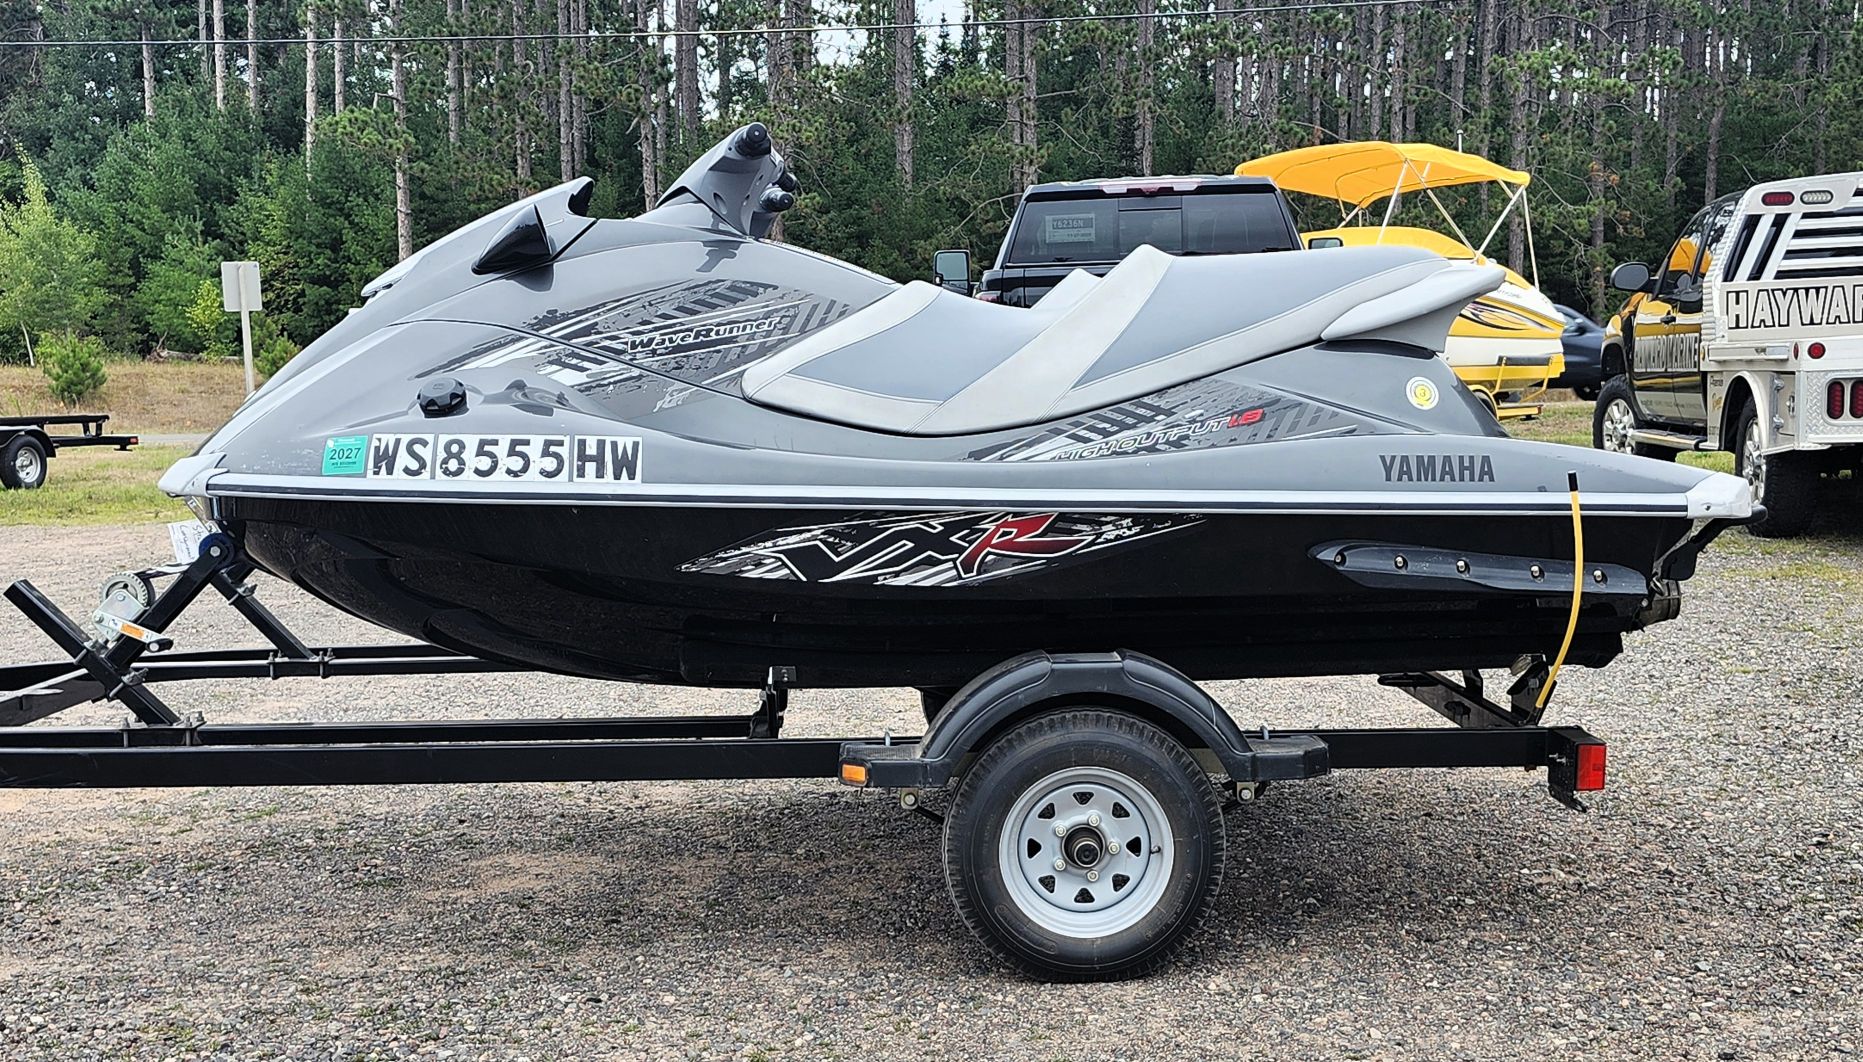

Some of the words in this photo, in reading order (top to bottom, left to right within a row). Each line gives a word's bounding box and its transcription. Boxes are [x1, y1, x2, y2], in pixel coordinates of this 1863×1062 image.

[628, 317, 780, 353] WaveRunner
[329, 447, 362, 460] 2027
[372, 437, 430, 477] WS
[439, 438, 565, 479] 8555
[575, 438, 640, 480] HW
[1378, 454, 1496, 482] YAMAHA
[752, 511, 1097, 582] VXR
